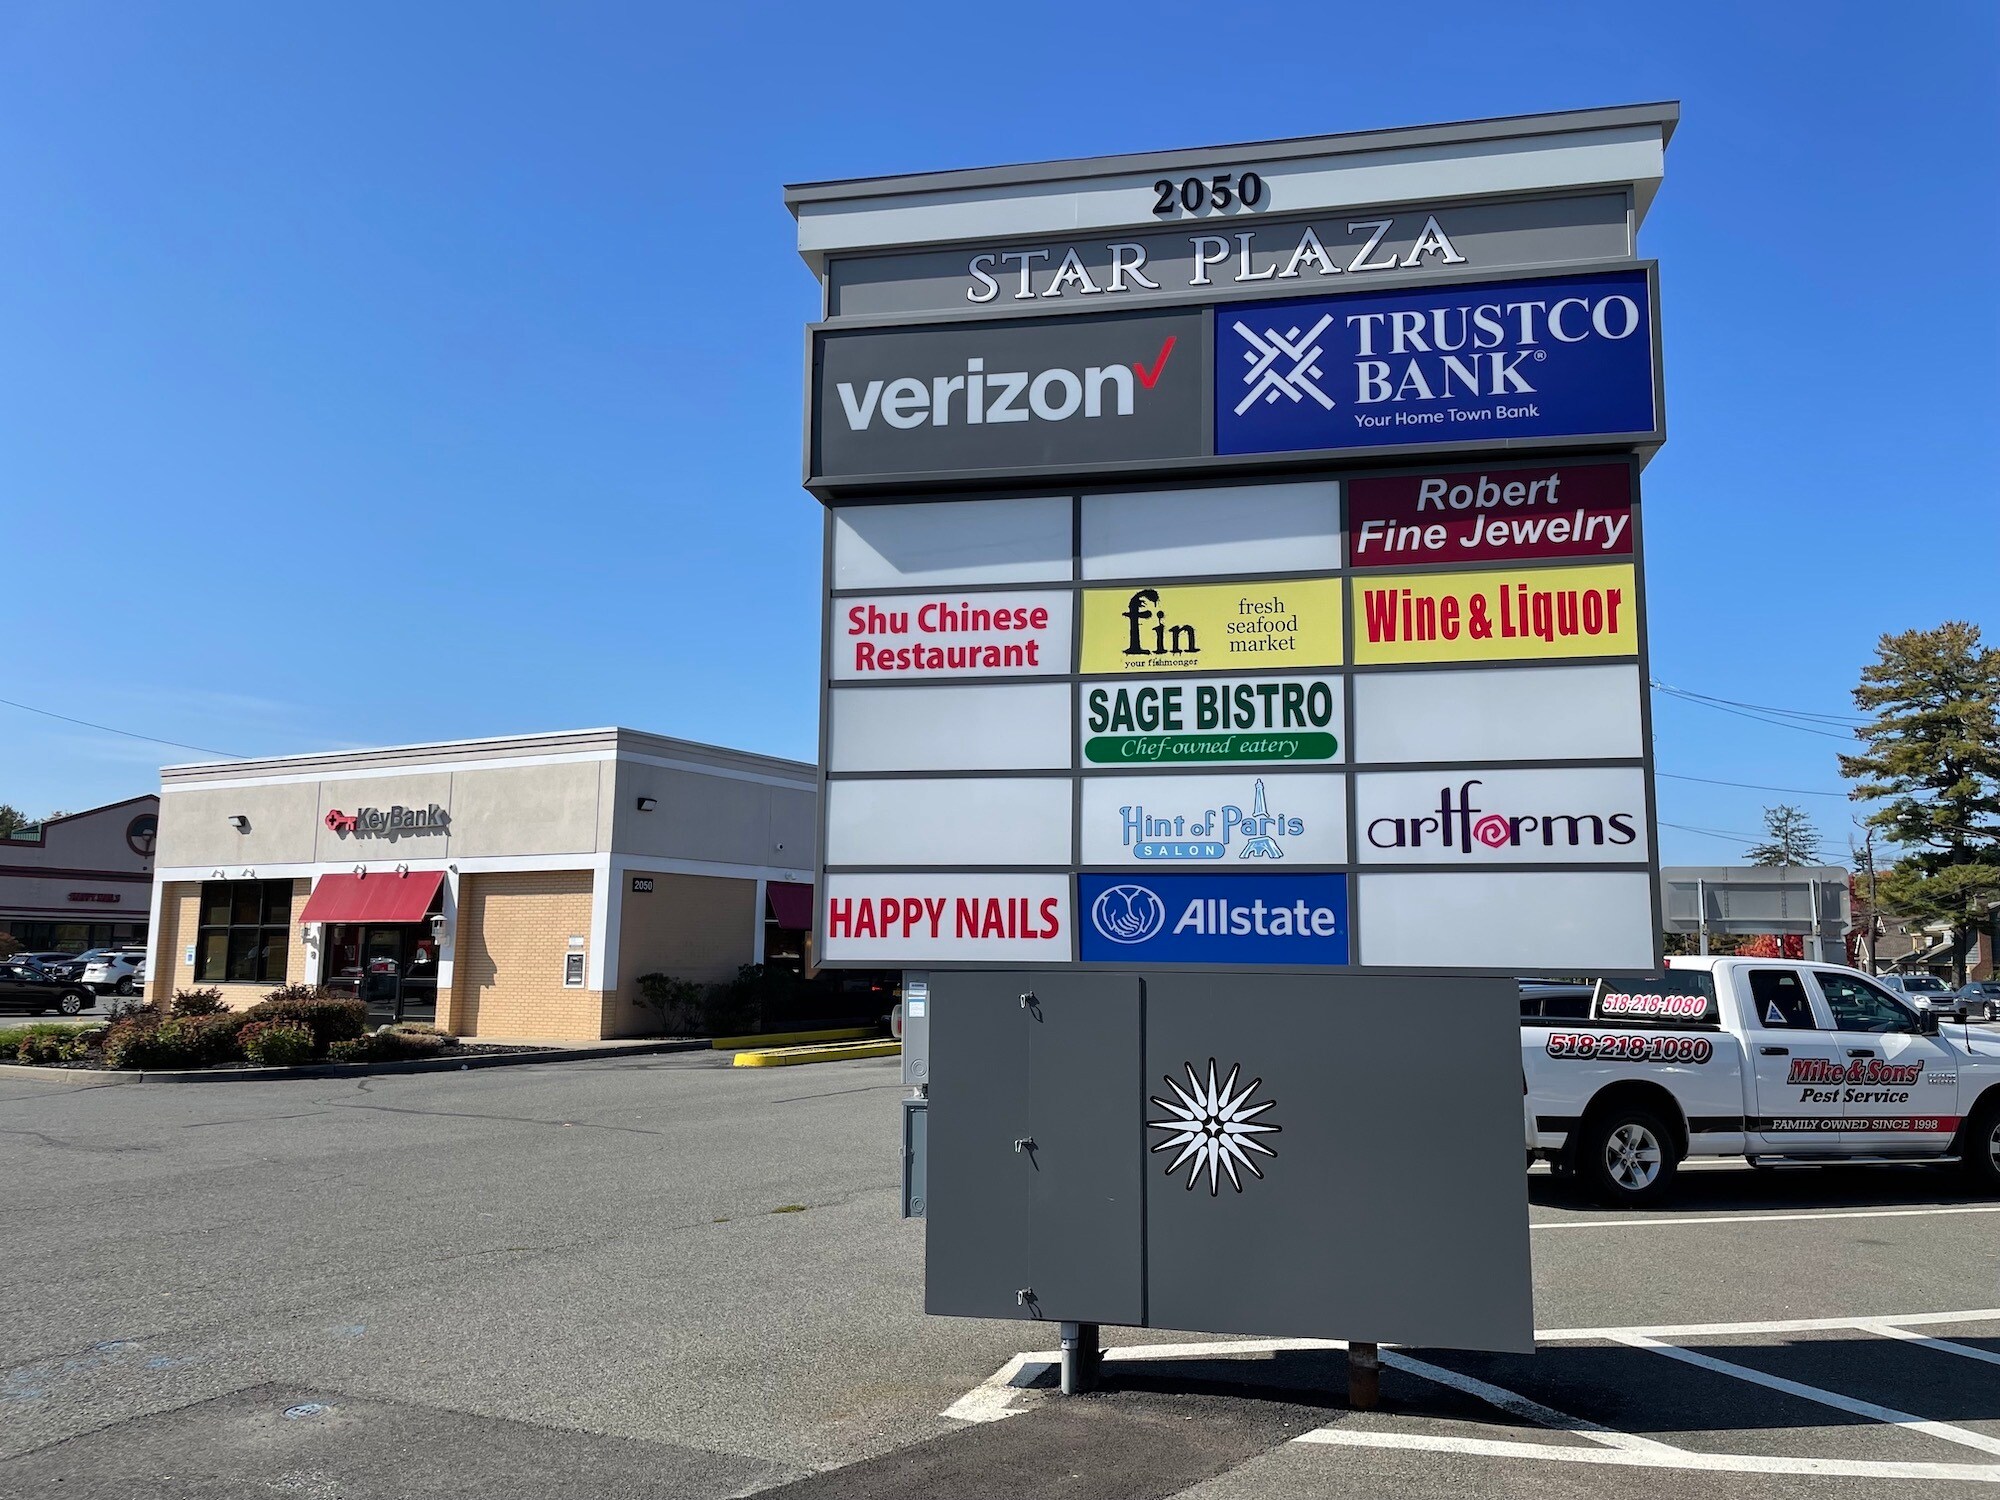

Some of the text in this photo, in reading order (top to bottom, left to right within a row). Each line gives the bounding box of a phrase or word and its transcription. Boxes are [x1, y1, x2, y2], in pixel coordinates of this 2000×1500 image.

[1152, 172, 1262, 214] 2050
[966, 214, 1467, 304] STAR PLAZA
[1345, 294, 1640, 358] TRUSTCO
[836, 357, 1135, 431] verizon
[1354, 403, 1540, 428] Your Home Town Bank
[1416, 472, 1561, 512] Robert
[1357, 508, 1630, 553] Fine Jewelry
[848, 601, 1049, 636] Shu Chinese
[1238, 596, 1285, 614] fresh
[1364, 583, 1622, 643] Wine & Liquor
[1121, 588, 1201, 656] fin
[1226, 615, 1298, 634] seafood
[855, 639, 1039, 671] Restaurant
[1229, 635, 1296, 653] market
[1125, 661, 1146, 669] your
[1088, 681, 1333, 733] SAGE BISTRO
[1121, 735, 1299, 760] Chef-owned eatery
[357, 804, 450, 834] KeyBank
[1118, 804, 1305, 845] Hint of Paris
[1367, 780, 1637, 854] artforms
[1144, 845, 1215, 856] SALON
[634, 880, 653, 891] 2050
[829, 897, 1059, 939] HAPPY NAILS
[1172, 898, 1335, 937] Allstate
[1602, 994, 1707, 1016] 518-218-1080
[1548, 1033, 1712, 1063] 518-218-1080
[1788, 1058, 1844, 1084] Mike
[1845, 1059, 1865, 1084] &
[1800, 1088, 1909, 1103] Pest Service
[1772, 1119, 1938, 1130] FAMILY OWNED SINCE 1998
